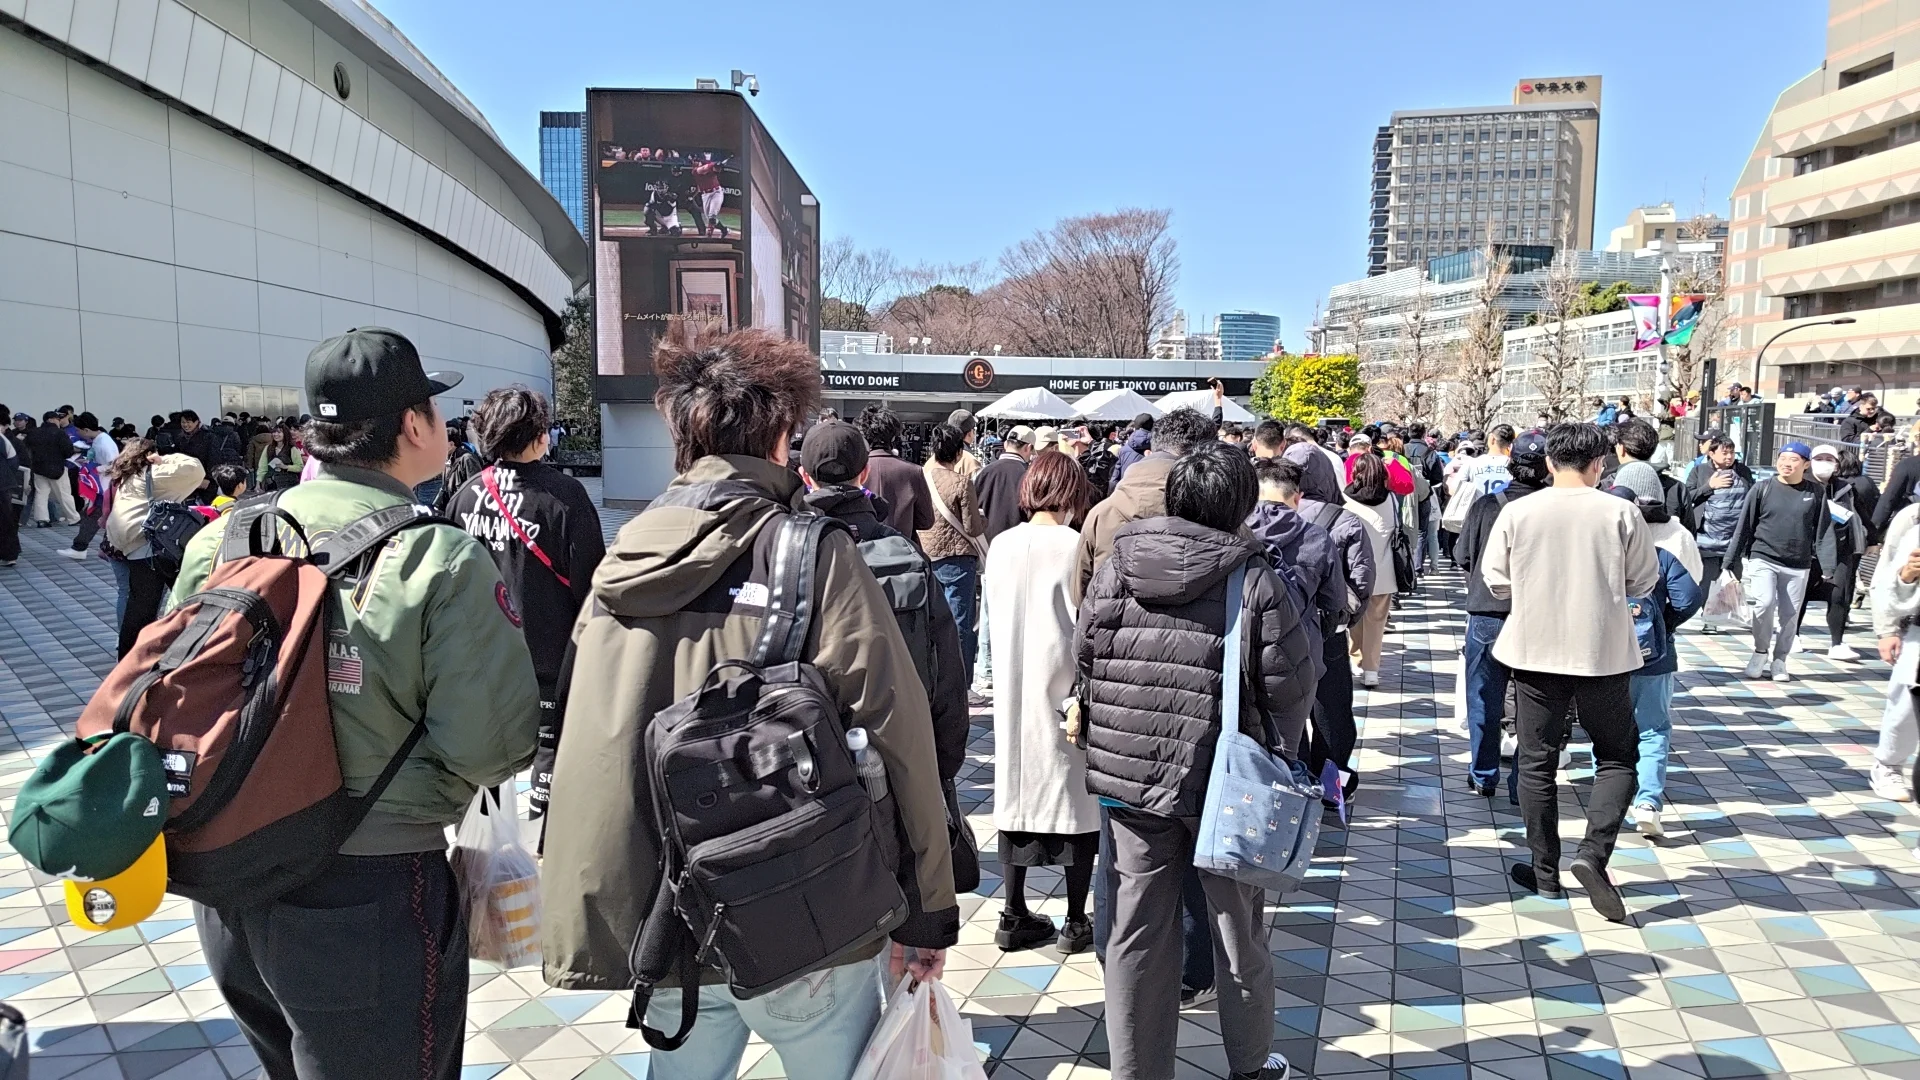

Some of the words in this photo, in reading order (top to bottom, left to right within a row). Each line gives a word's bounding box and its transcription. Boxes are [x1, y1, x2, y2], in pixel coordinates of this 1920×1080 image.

[828, 375, 865, 386] TOKYO
[868, 376, 900, 387] DOME
[1050, 380, 1080, 389] HOME
[1083, 381, 1096, 389] OF
[1099, 381, 1119, 390] THE
[1122, 381, 1156, 391] TOKYO
[1159, 382, 1198, 391] GIANTS
[329, 684, 361, 694] IRAMAR
